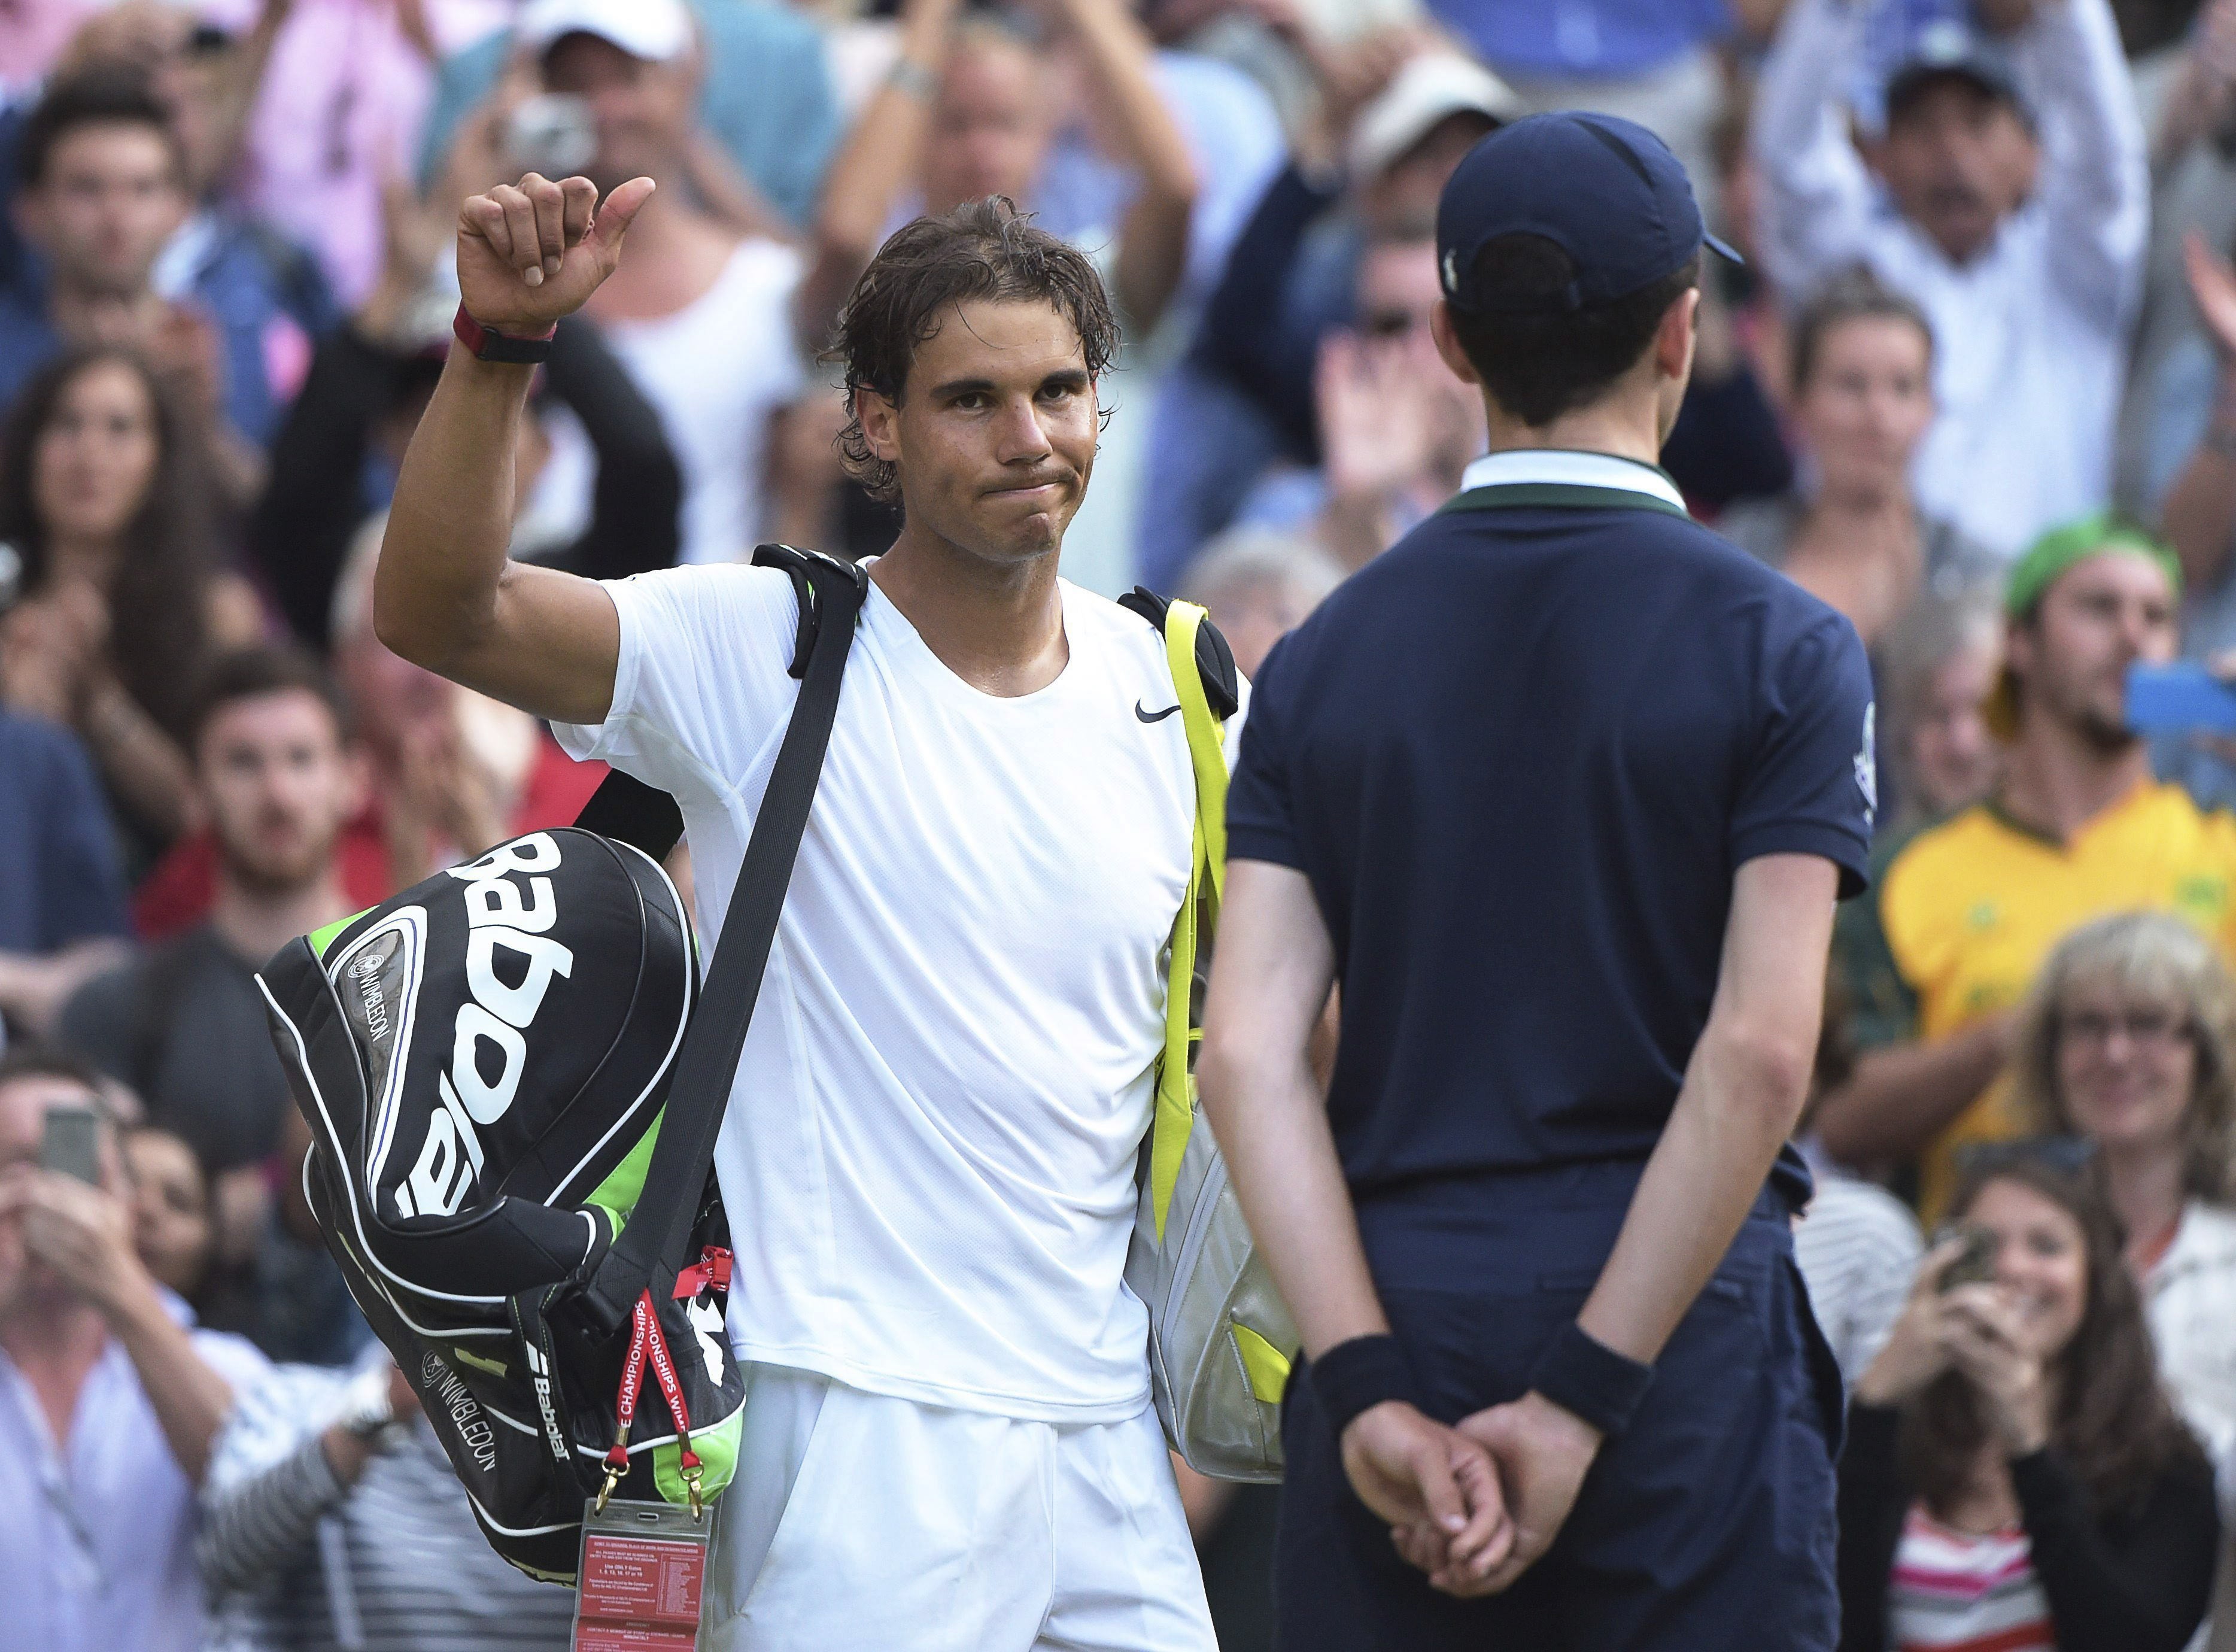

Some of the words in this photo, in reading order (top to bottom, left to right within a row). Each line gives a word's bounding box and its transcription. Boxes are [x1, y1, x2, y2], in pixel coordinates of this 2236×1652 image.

[359, 971, 390, 1042] WIMBLEDON
[621, 1300, 646, 1414] CHAMPIONSHIPS
[438, 1371, 496, 1472] WIMBLEDON
[534, 1377, 570, 1463] Babolat
